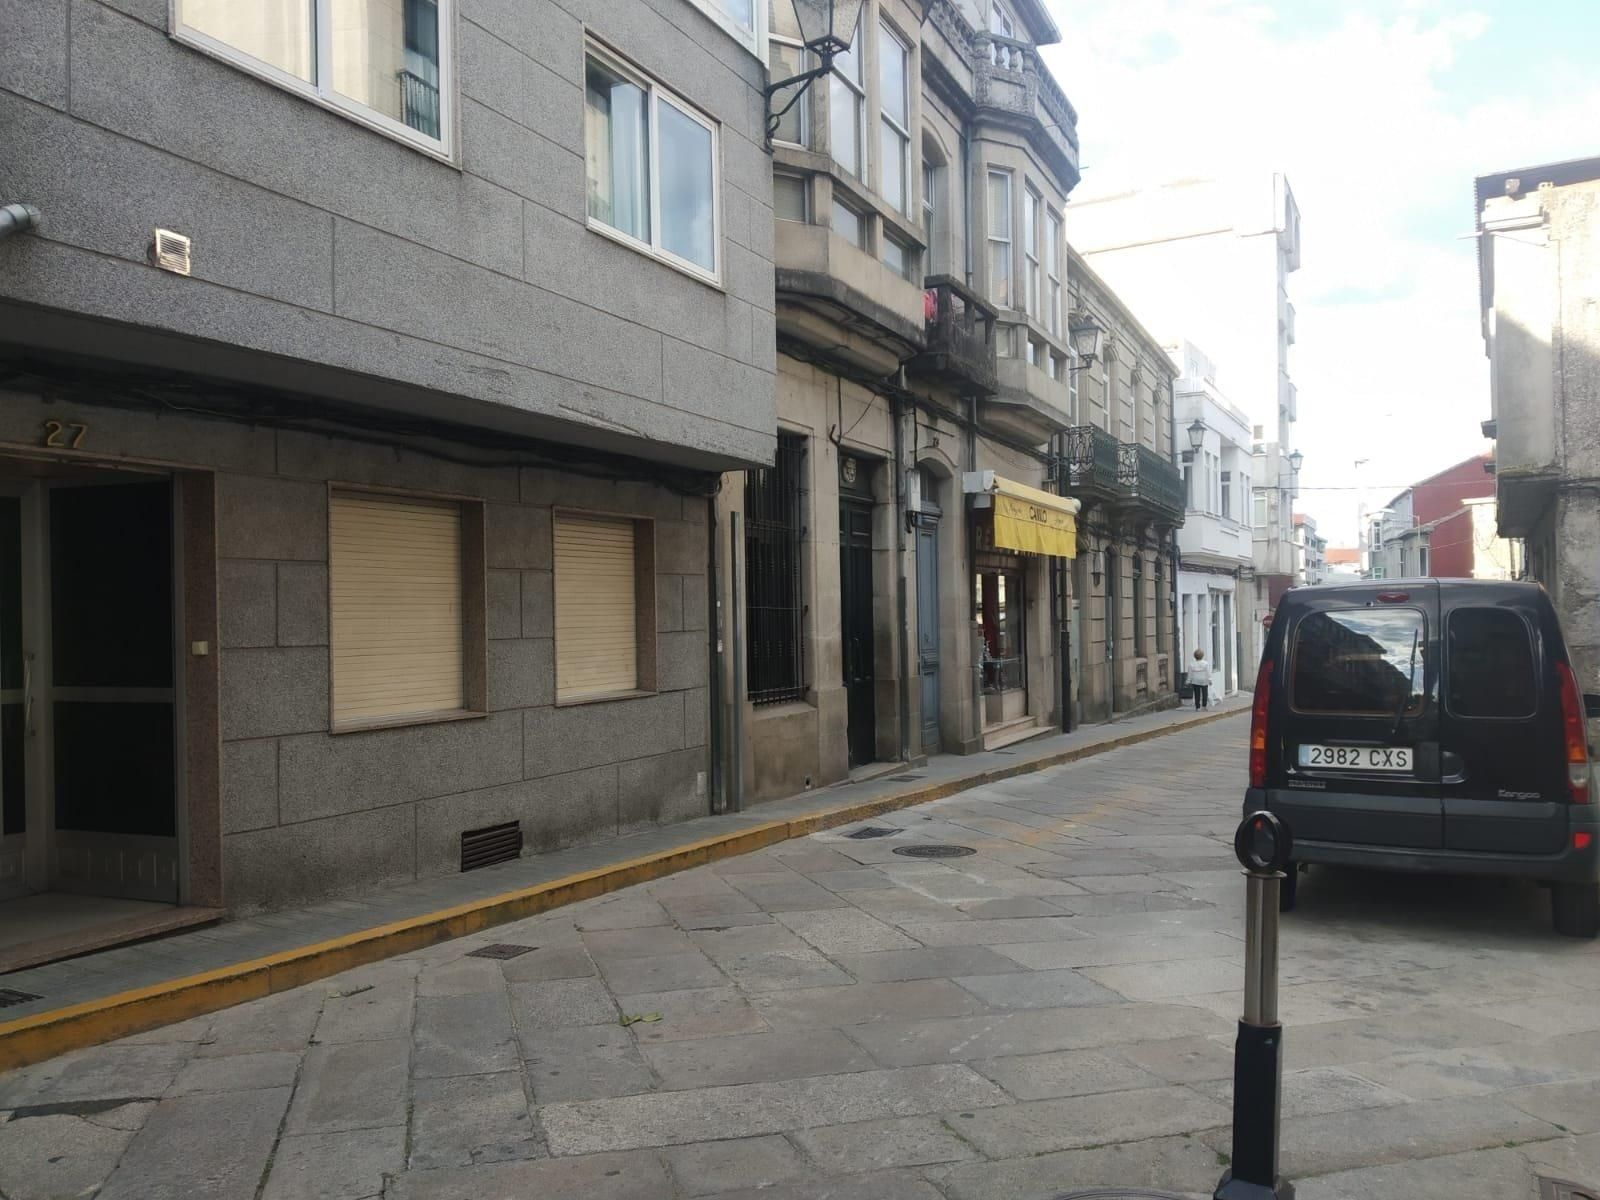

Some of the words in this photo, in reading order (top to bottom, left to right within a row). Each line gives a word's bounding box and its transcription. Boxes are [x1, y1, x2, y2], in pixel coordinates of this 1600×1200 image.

[45, 420, 88, 449] 27
[1310, 747, 1361, 766] 2982
[1369, 749, 1408, 768] CXS
